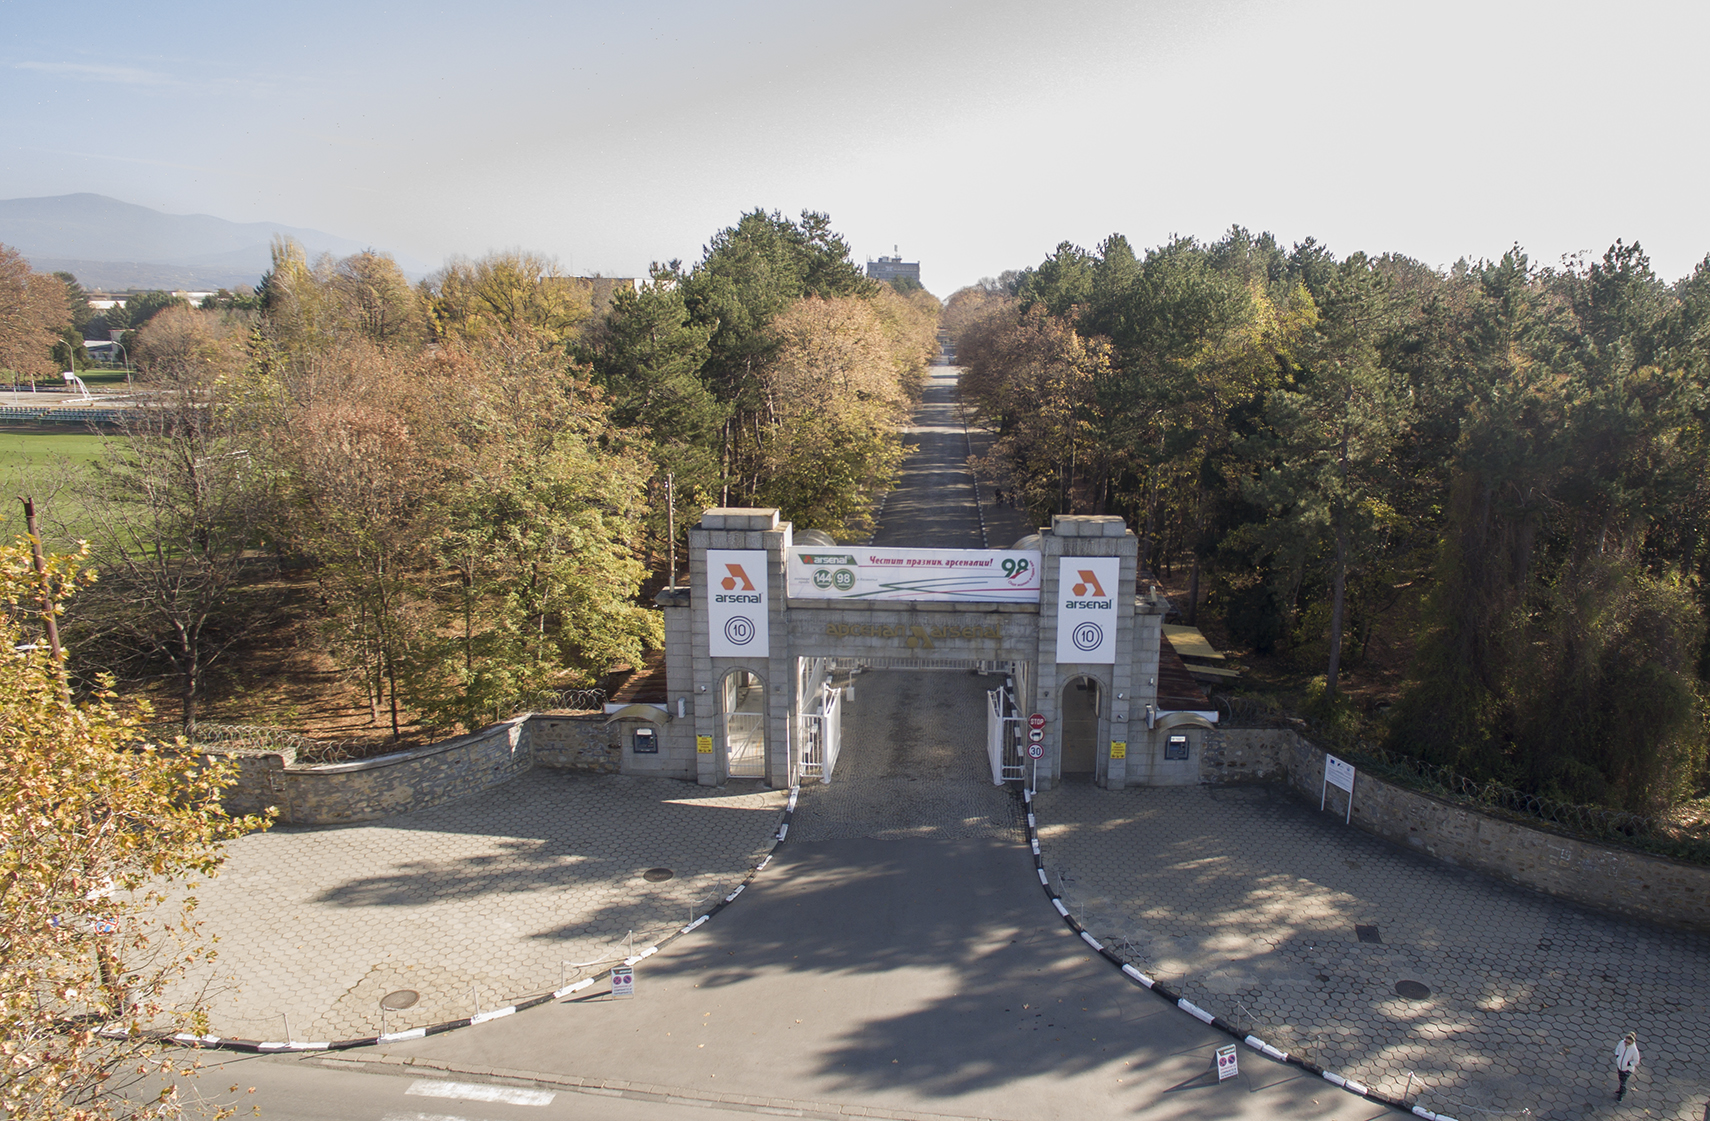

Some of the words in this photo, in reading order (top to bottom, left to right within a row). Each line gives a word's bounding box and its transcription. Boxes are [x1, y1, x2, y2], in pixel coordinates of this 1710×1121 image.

[813, 555, 848, 565] arsenal
[869, 555, 904, 565] Честит
[945, 558, 994, 569] арсеналци!
[1001, 558, 1029, 578] 98
[814, 572, 833, 583] 144
[837, 573, 851, 583] 98
[715, 593, 762, 604] arsenal
[1065, 599, 1112, 610] arsenal
[733, 624, 747, 637] 10
[930, 622, 1003, 639] arsenal
[1081, 629, 1095, 643] 10
[1030, 747, 1041, 756] 30
